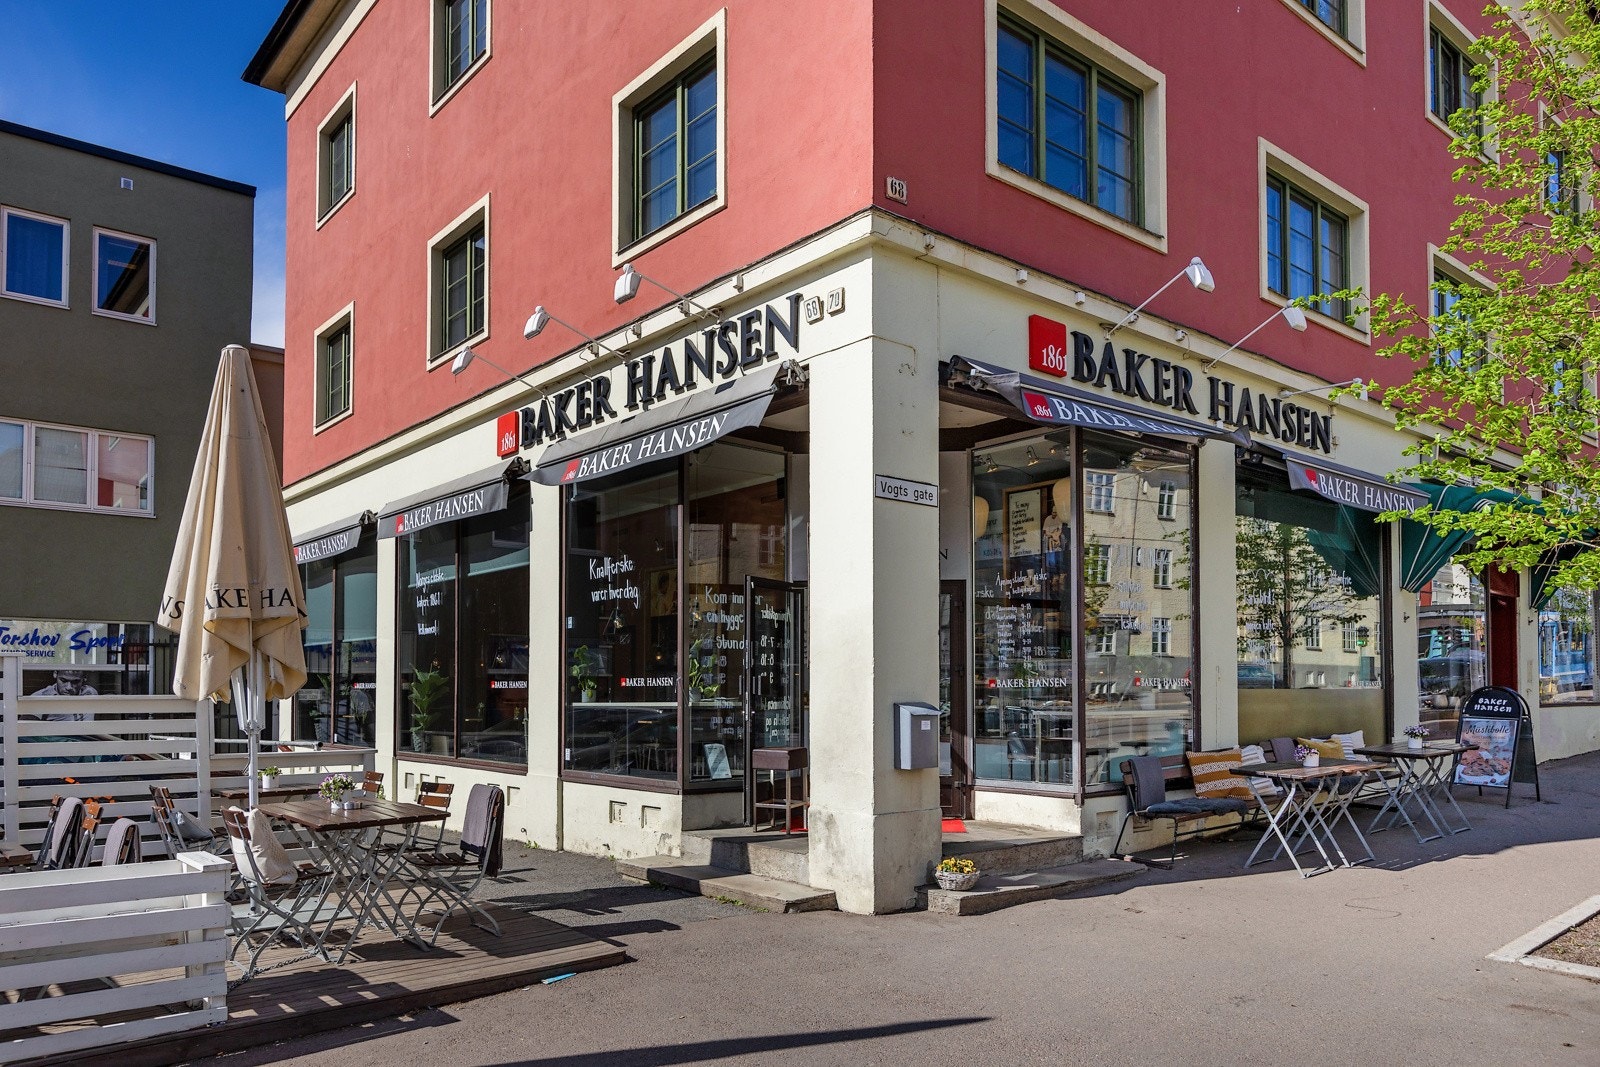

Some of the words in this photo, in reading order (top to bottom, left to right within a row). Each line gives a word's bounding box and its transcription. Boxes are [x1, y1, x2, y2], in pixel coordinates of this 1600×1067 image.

[890, 180, 904, 198] 68
[806, 300, 818, 318] 68
[830, 292, 840, 310] 70
[501, 430, 516, 452] 1861
[520, 374, 618, 450] BAKER
[624, 292, 804, 412] HANSEN
[1041, 344, 1067, 372] 1861
[1070, 330, 1200, 416] BAKER
[1207, 376, 1332, 454] HANSEN
[1034, 404, 1053, 417] 1861
[577, 443, 633, 479] BAKER
[638, 412, 730, 458] HANSEN
[881, 480, 908, 498] Vogts
[914, 488, 934, 501] gate
[1319, 473, 1361, 504] BAKER
[1364, 485, 1415, 514] HANSEN
[403, 506, 432, 531] BAKER
[433, 489, 485, 521] HANSEN
[298, 542, 321, 561] BAKER
[321, 532, 349, 555] HANSEN
[589, 554, 635, 582] Knallferske
[705, 585, 728, 604] Kom
[732, 592, 744, 604] inn
[69, 629, 126, 655] Sport
[494, 681, 508, 689] BAKER
[508, 680, 528, 689] HANSEN
[626, 677, 645, 687] BAKER
[646, 677, 673, 687] HANSEN
[996, 679, 1024, 688] BAKER
[1028, 677, 1067, 688] HANSEN
[1141, 678, 1160, 687] BAKER
[1163, 678, 1189, 687] HANSEN
